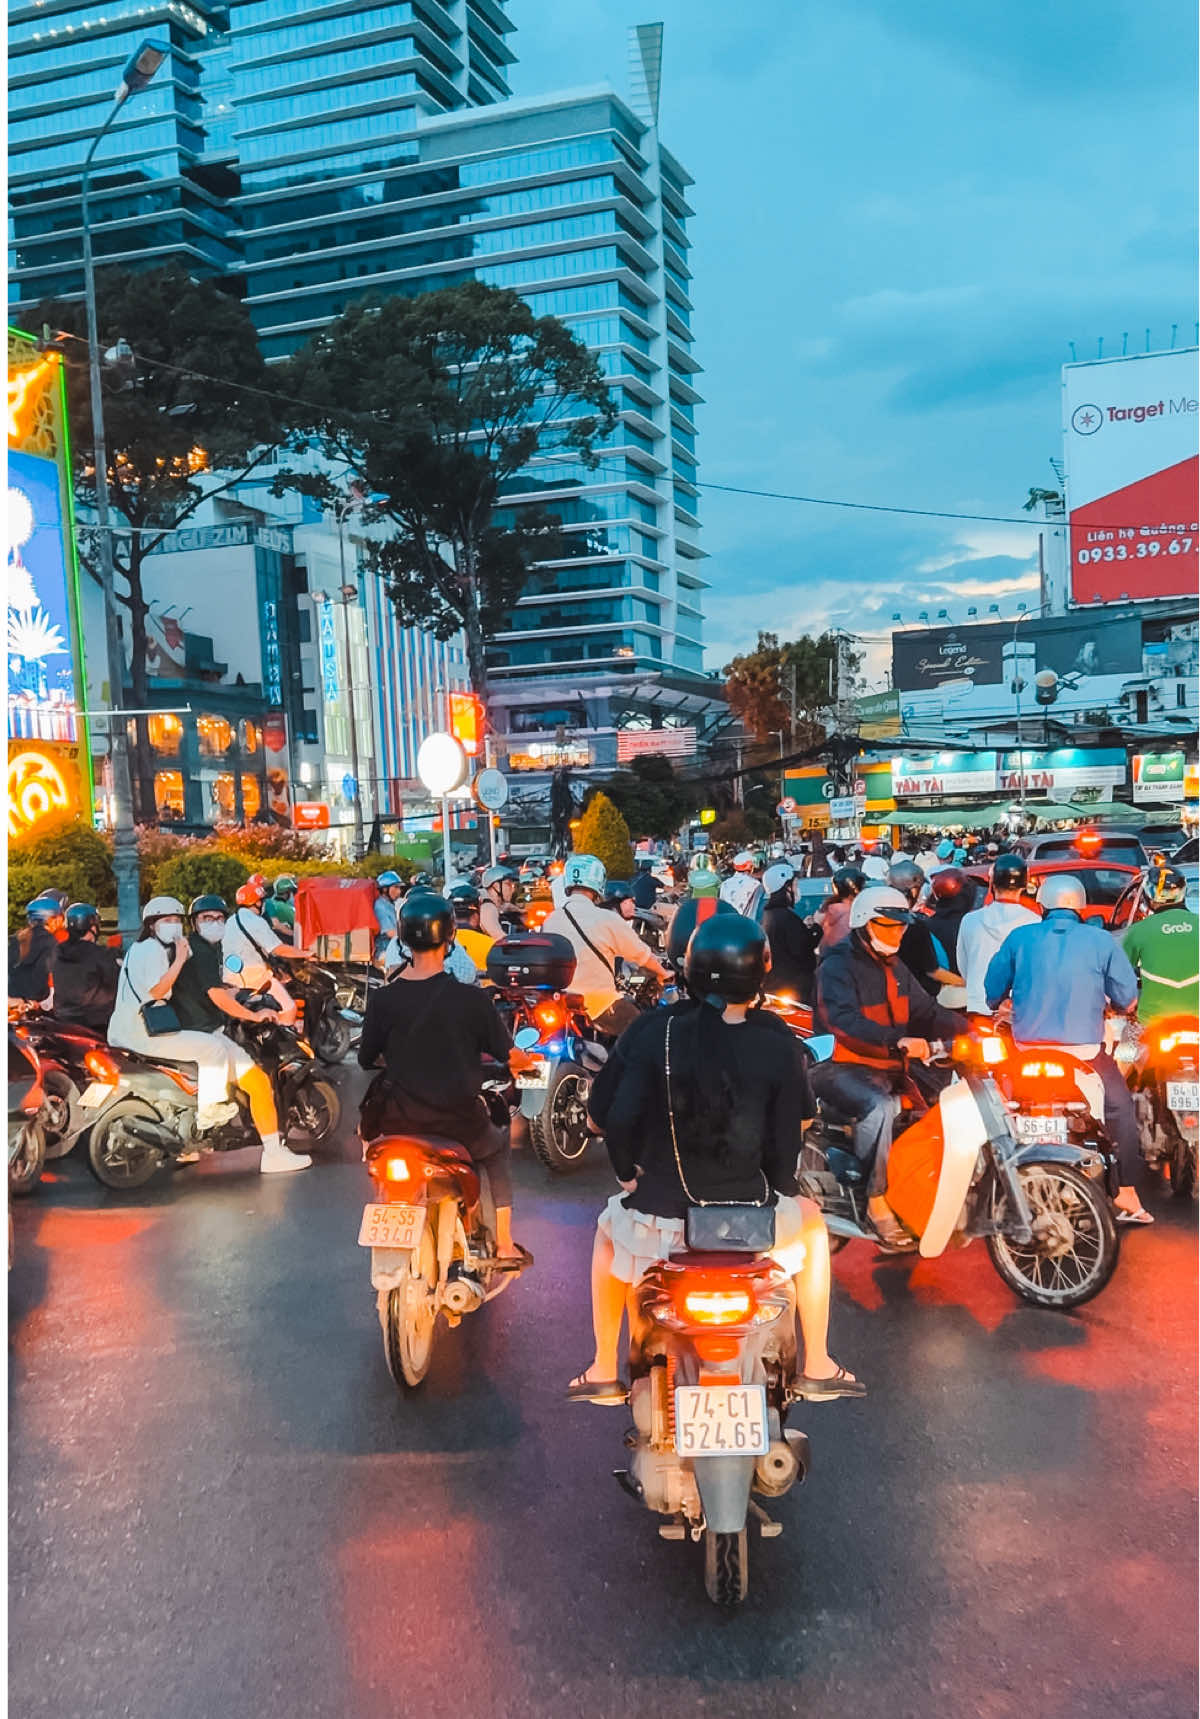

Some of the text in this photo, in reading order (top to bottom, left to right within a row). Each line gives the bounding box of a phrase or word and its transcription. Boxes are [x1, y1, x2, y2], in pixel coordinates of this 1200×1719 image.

[1106, 400, 1165, 423] Target
[939, 644, 968, 655] Legend
[1161, 921, 1193, 935] Grab
[372, 1208, 417, 1226] 54-S5
[689, 1391, 749, 1419] 74-C1
[682, 1421, 763, 1449] 524.65
